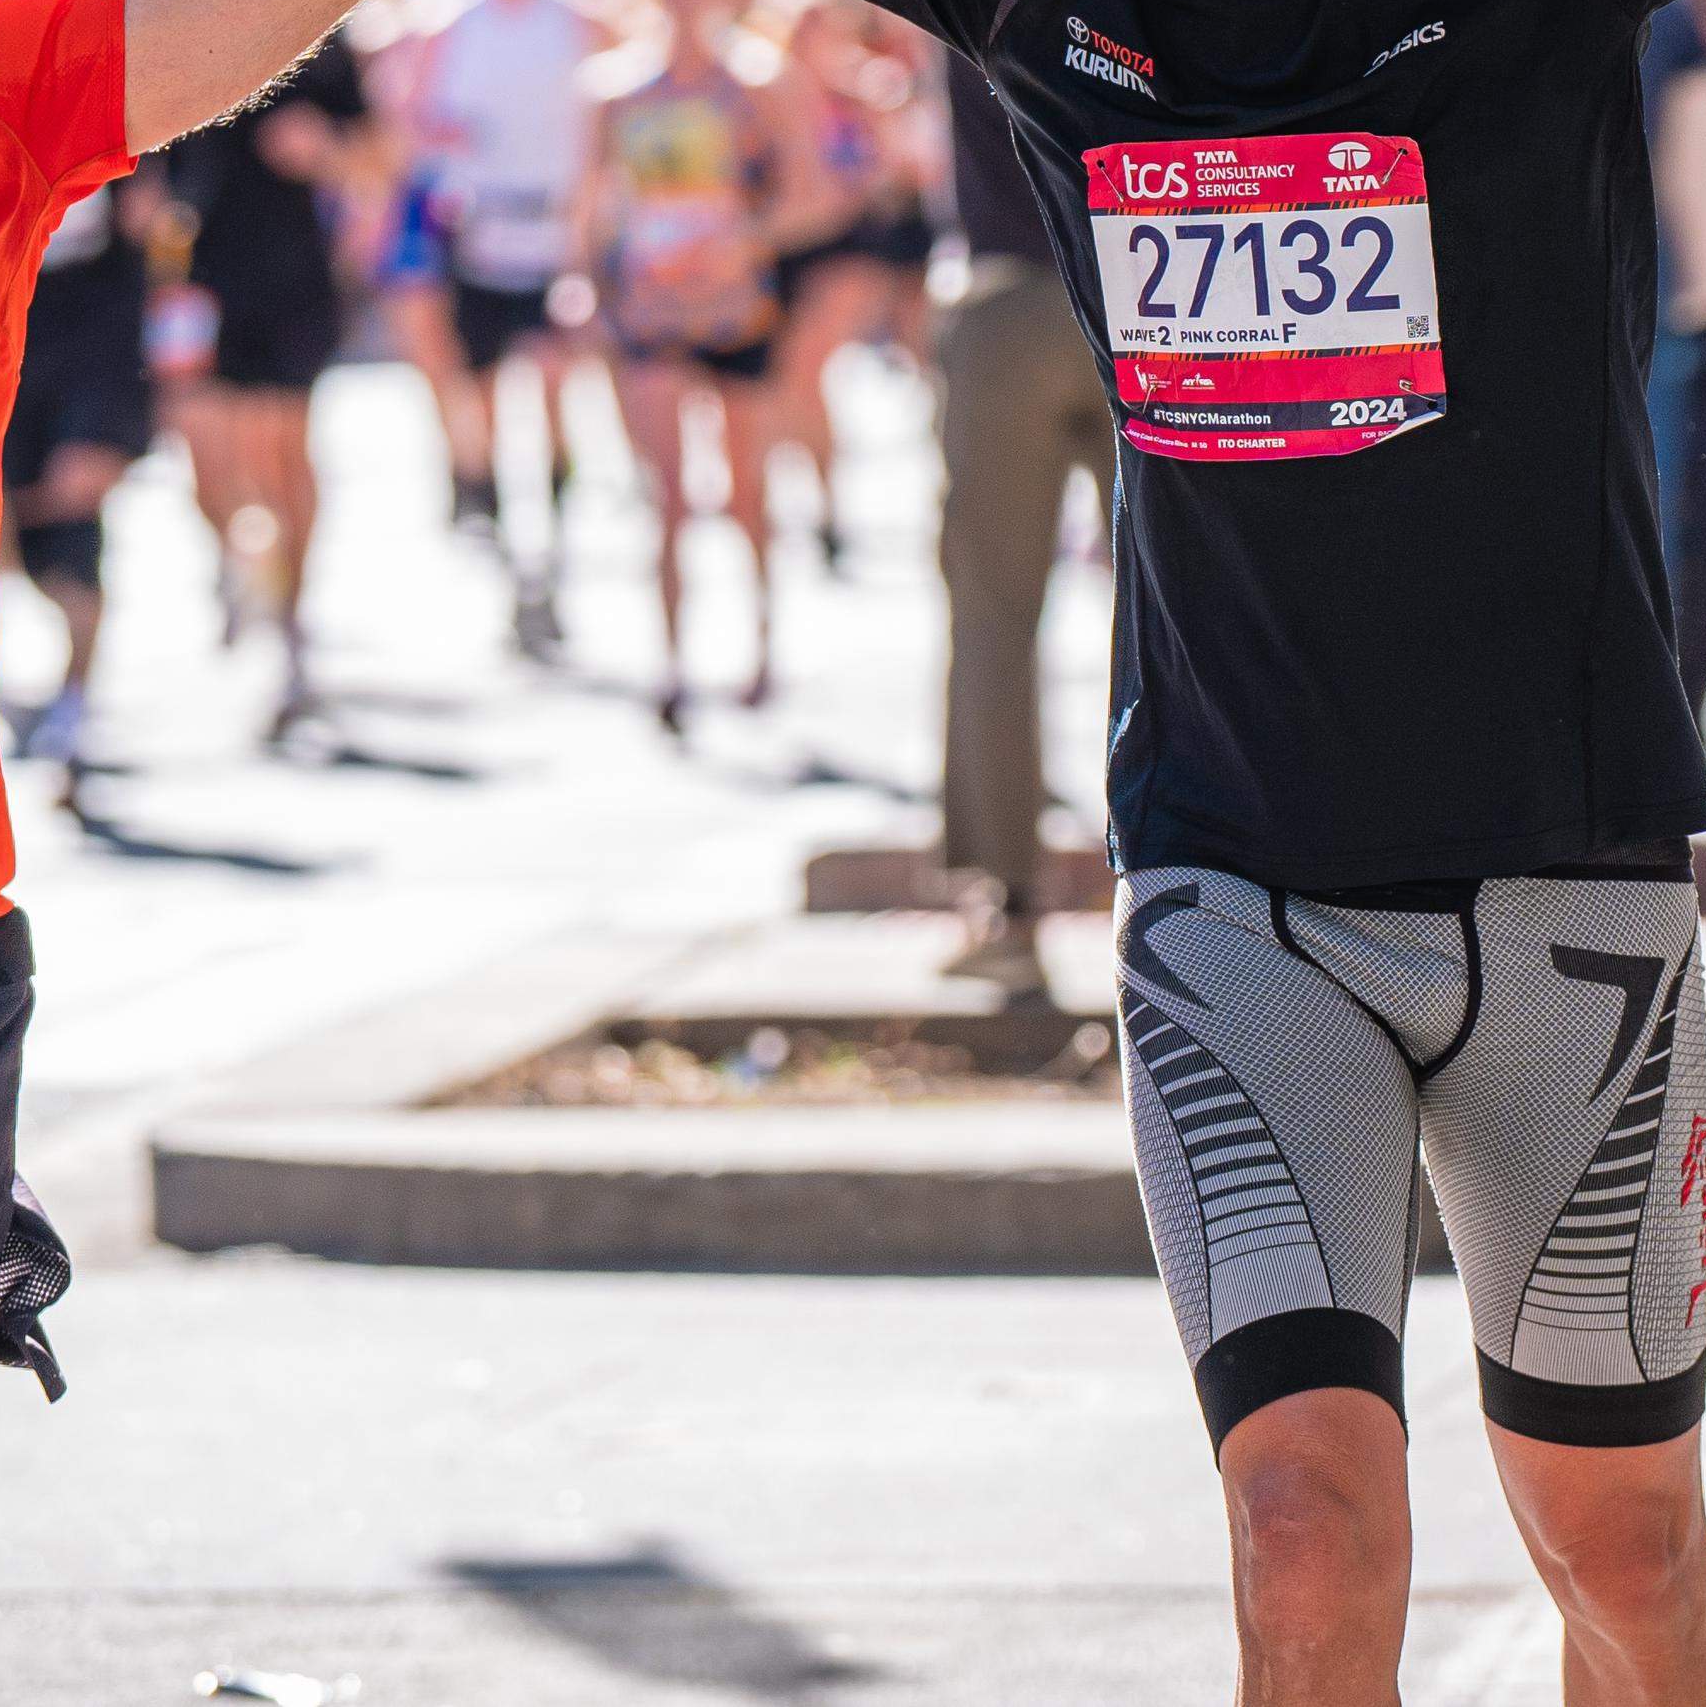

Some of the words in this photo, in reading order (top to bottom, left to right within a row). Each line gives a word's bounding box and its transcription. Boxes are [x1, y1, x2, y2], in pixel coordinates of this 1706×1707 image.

[1091, 30, 1155, 77] TOYOTA
[1193, 150, 1238, 164] TATA
[1122, 153, 1189, 199] tcs
[1195, 164, 1295, 181] CONSULTANCY
[1197, 182, 1260, 198] SERVICES
[1322, 175, 1381, 193] TATA
[1128, 216, 1401, 319] 27132
[1120, 329, 1157, 343] WAVE
[1157, 325, 1172, 346] 2
[1180, 330, 1214, 343] PINK
[1216, 328, 1280, 343] CORRAL
[1282, 322, 1297, 344] F
[1154, 408, 1272, 425] #TCSNYCMarathon
[1329, 397, 1408, 426] 2024
[1217, 438, 1235, 449] ITO
[1236, 438, 1286, 449] CHARTER
